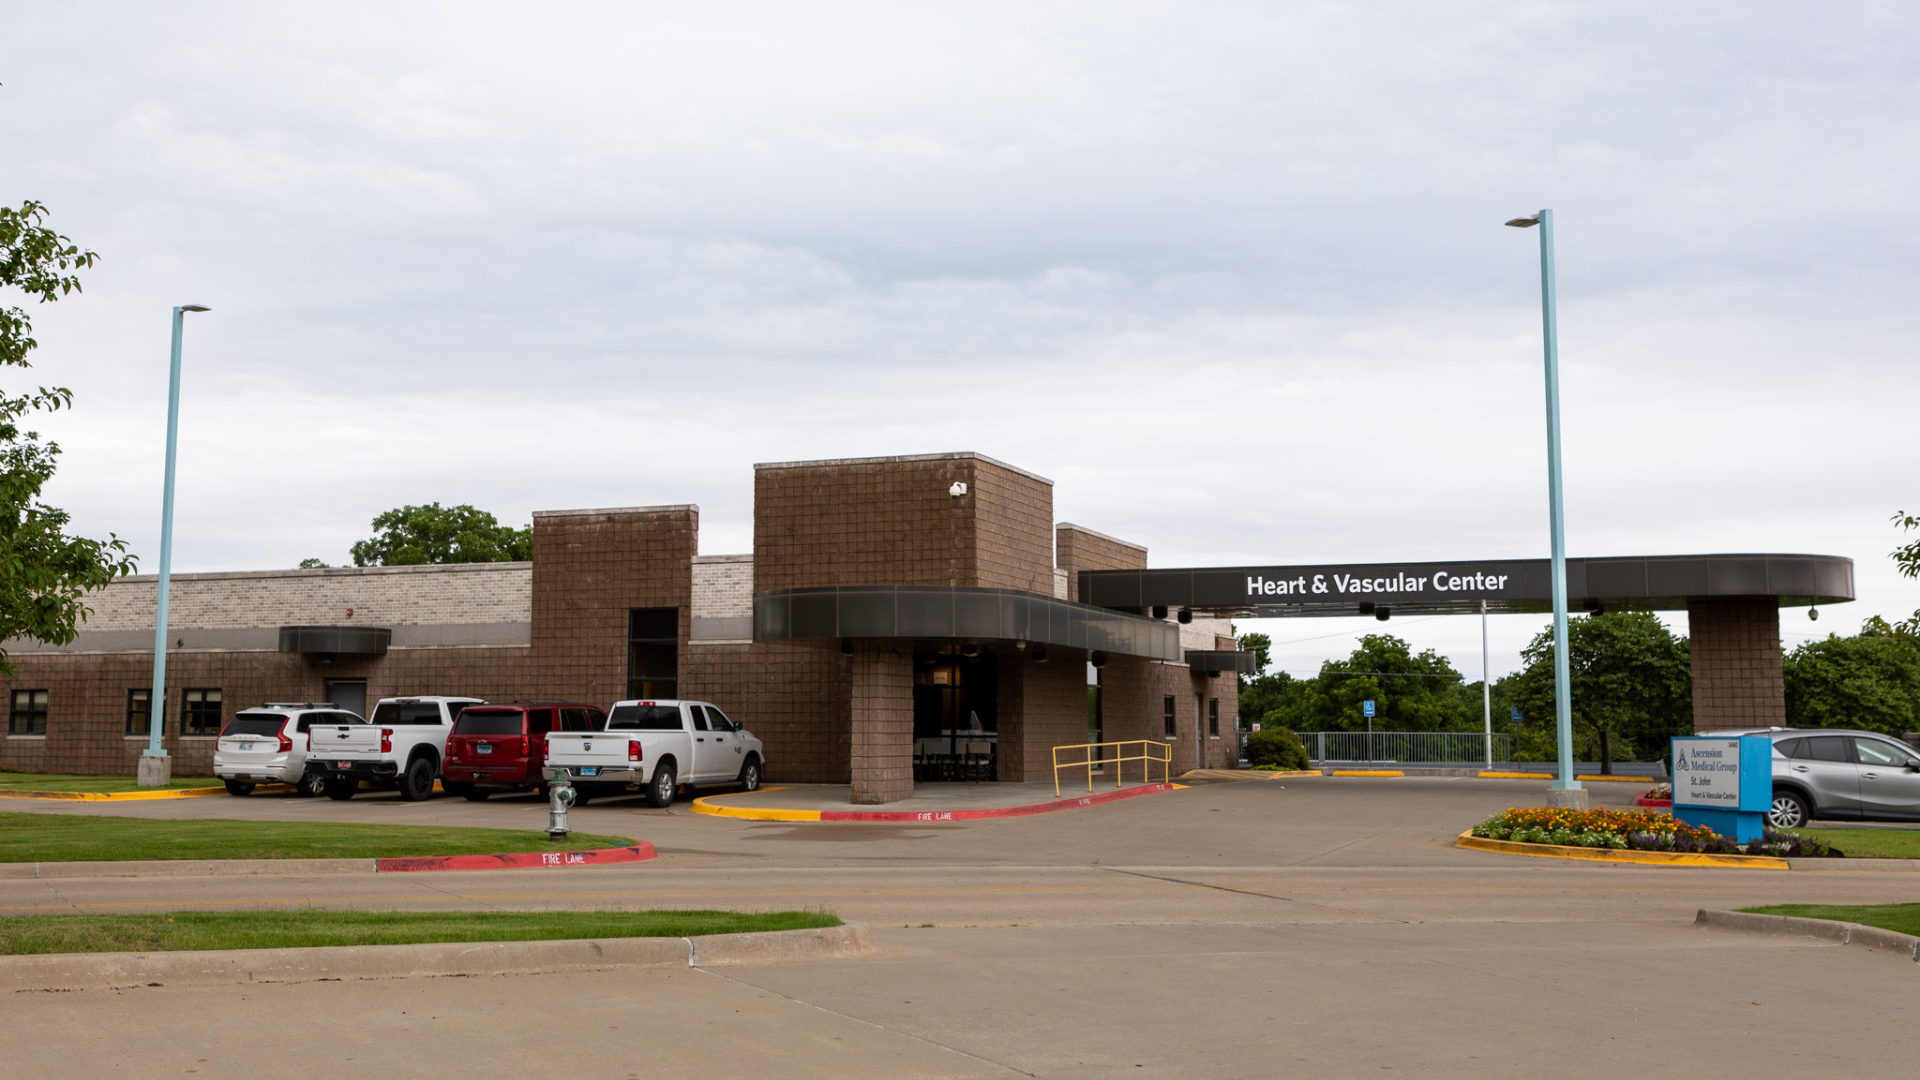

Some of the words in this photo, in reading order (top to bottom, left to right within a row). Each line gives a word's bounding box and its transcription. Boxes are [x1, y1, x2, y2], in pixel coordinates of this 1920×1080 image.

[1247, 576, 1306, 596] Heart
[1311, 574, 1329, 594] &
[1333, 572, 1428, 593] Vascular
[1432, 571, 1508, 591] Center
[1691, 747, 1723, 758] Ascension
[1691, 761, 1715, 771] Medical
[1716, 761, 1738, 774] Group
[1699, 776, 1711, 786] John
[1723, 792, 1737, 800] Center
[936, 812, 952, 820] LANE
[542, 853, 561, 864] FIRE
[564, 853, 586, 864] LANE
